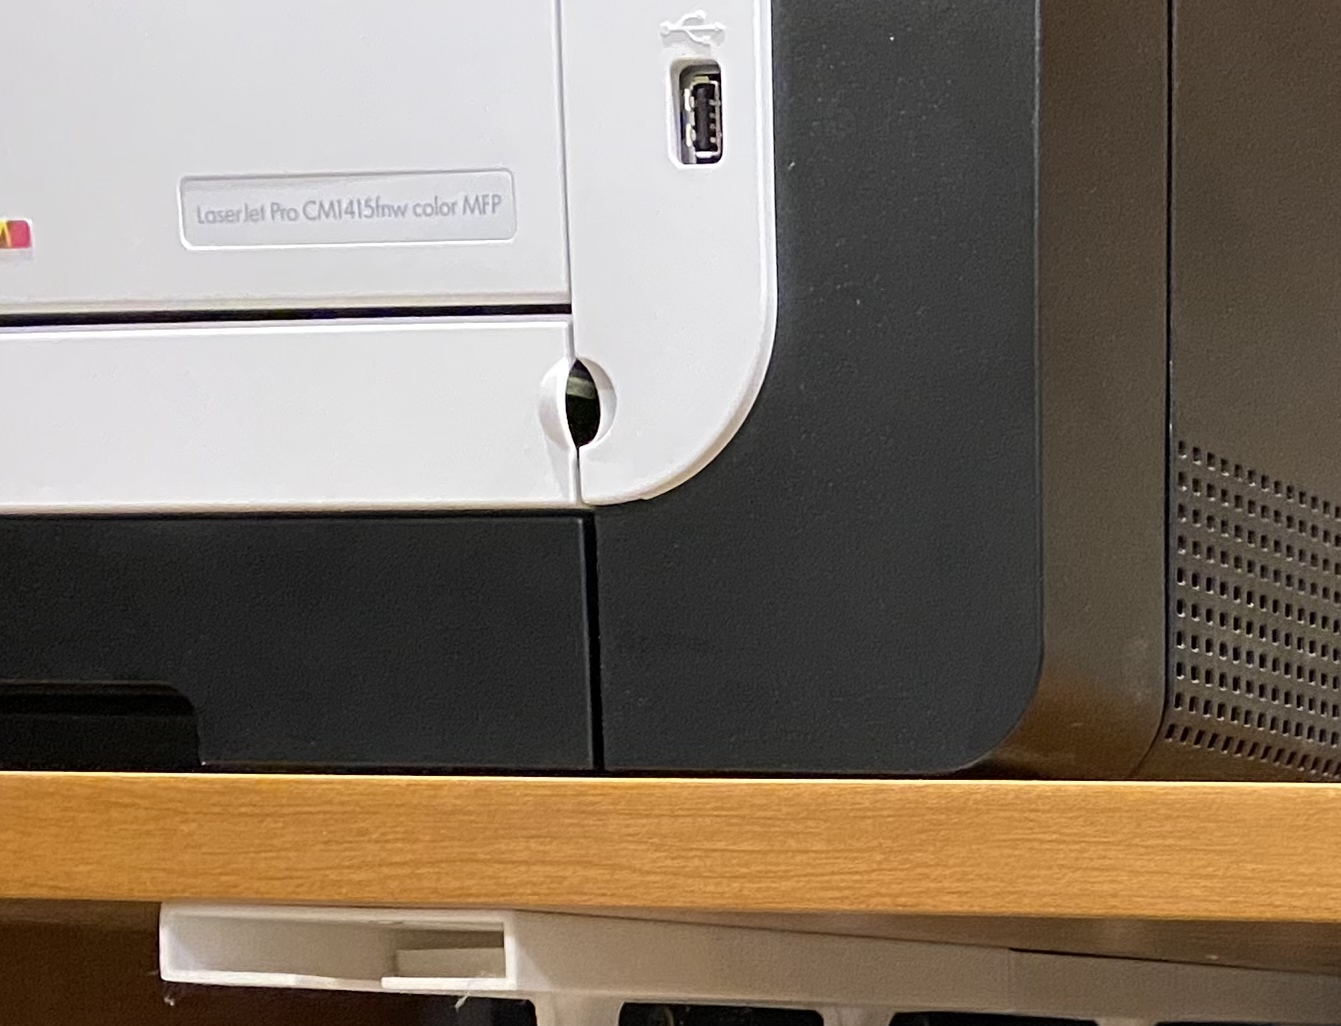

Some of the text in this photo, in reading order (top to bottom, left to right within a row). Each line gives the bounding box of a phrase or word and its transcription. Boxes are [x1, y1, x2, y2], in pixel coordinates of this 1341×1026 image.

[270, 202, 299, 222] Pro
[303, 196, 408, 221] CM1415fnw
[412, 195, 458, 218] color
[462, 193, 502, 216] MFP
